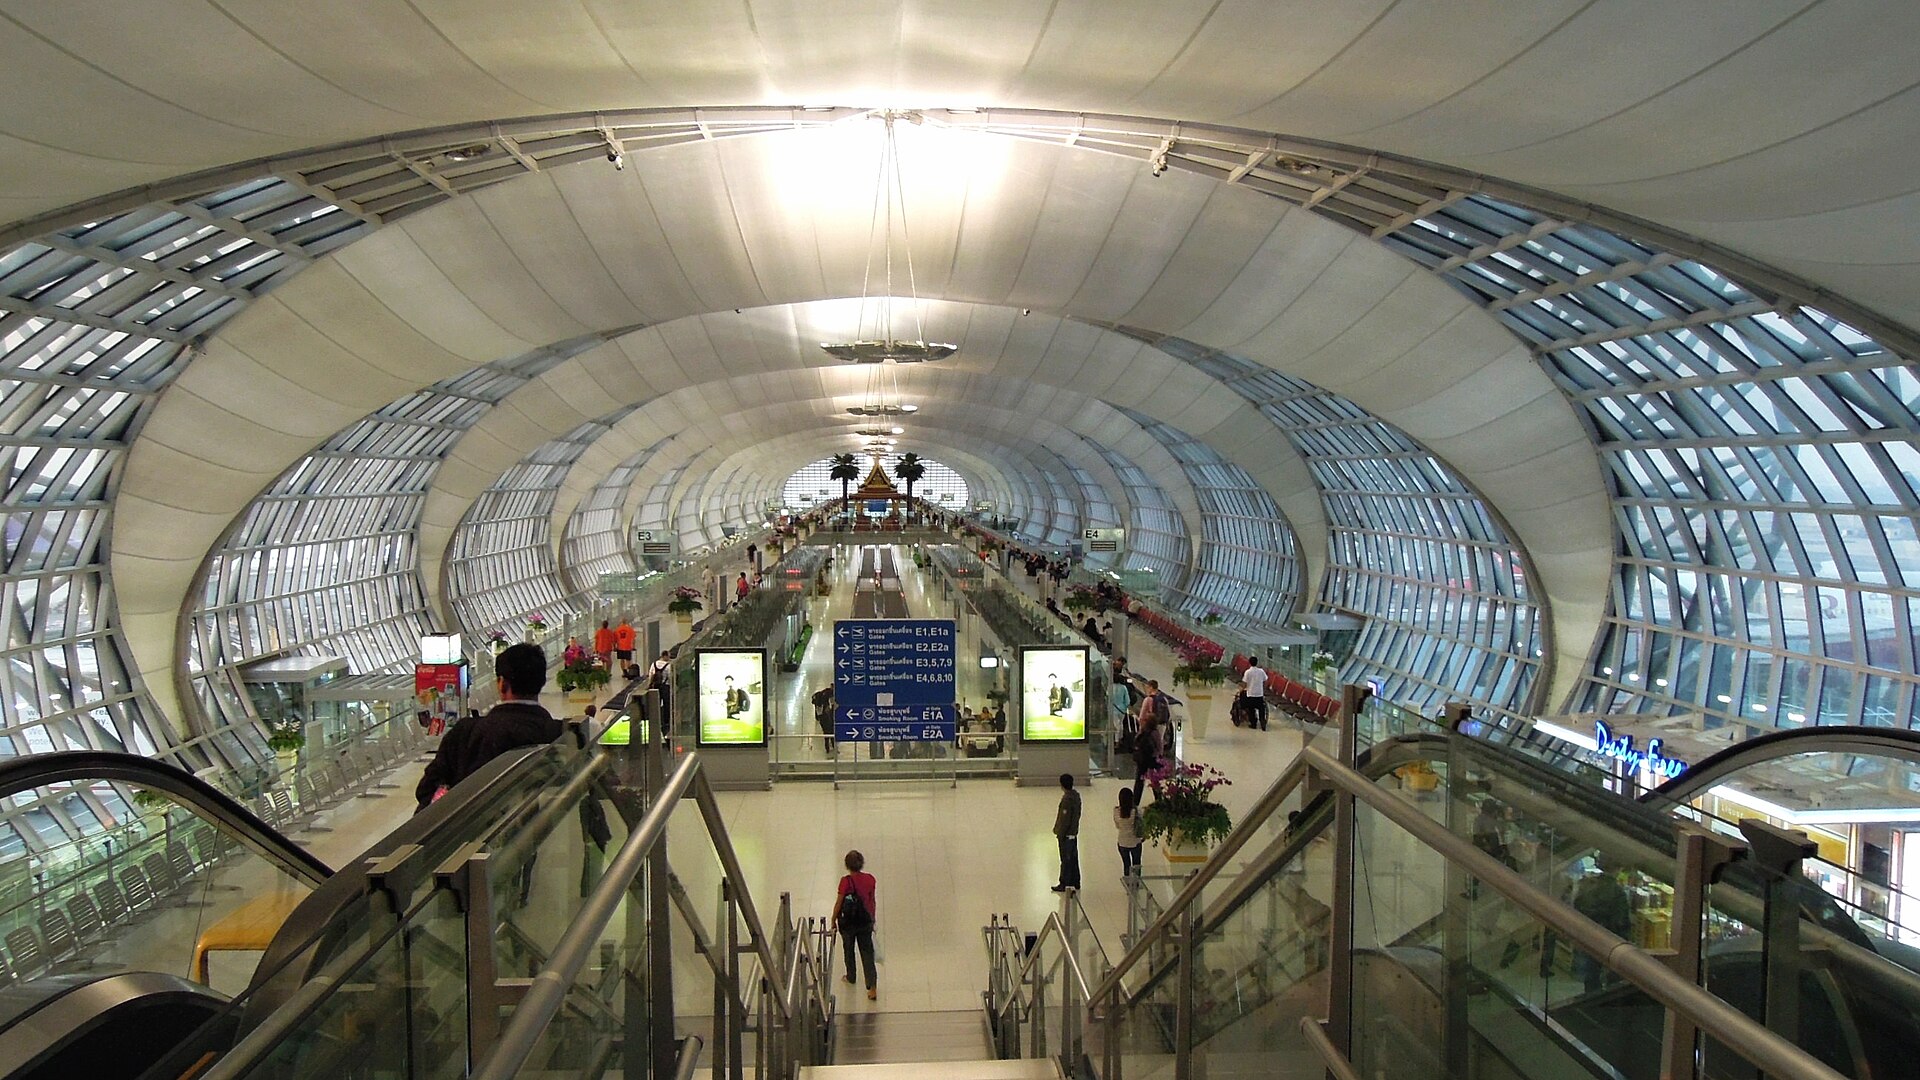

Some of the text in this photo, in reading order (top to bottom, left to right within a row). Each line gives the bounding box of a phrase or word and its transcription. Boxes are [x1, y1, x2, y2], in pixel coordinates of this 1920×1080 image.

[638, 532, 651, 541] E3
[1085, 530, 1098, 539] E4
[915, 627, 949, 637] E1,E1a
[916, 642, 949, 653] E2,E2a
[916, 658, 953, 668] E3,5,7,9
[916, 674, 953, 684] E4,6,8,10
[922, 711, 944, 721] E1A
[922, 729, 944, 739] E2A
[1595, 720, 1640, 776] Duty
